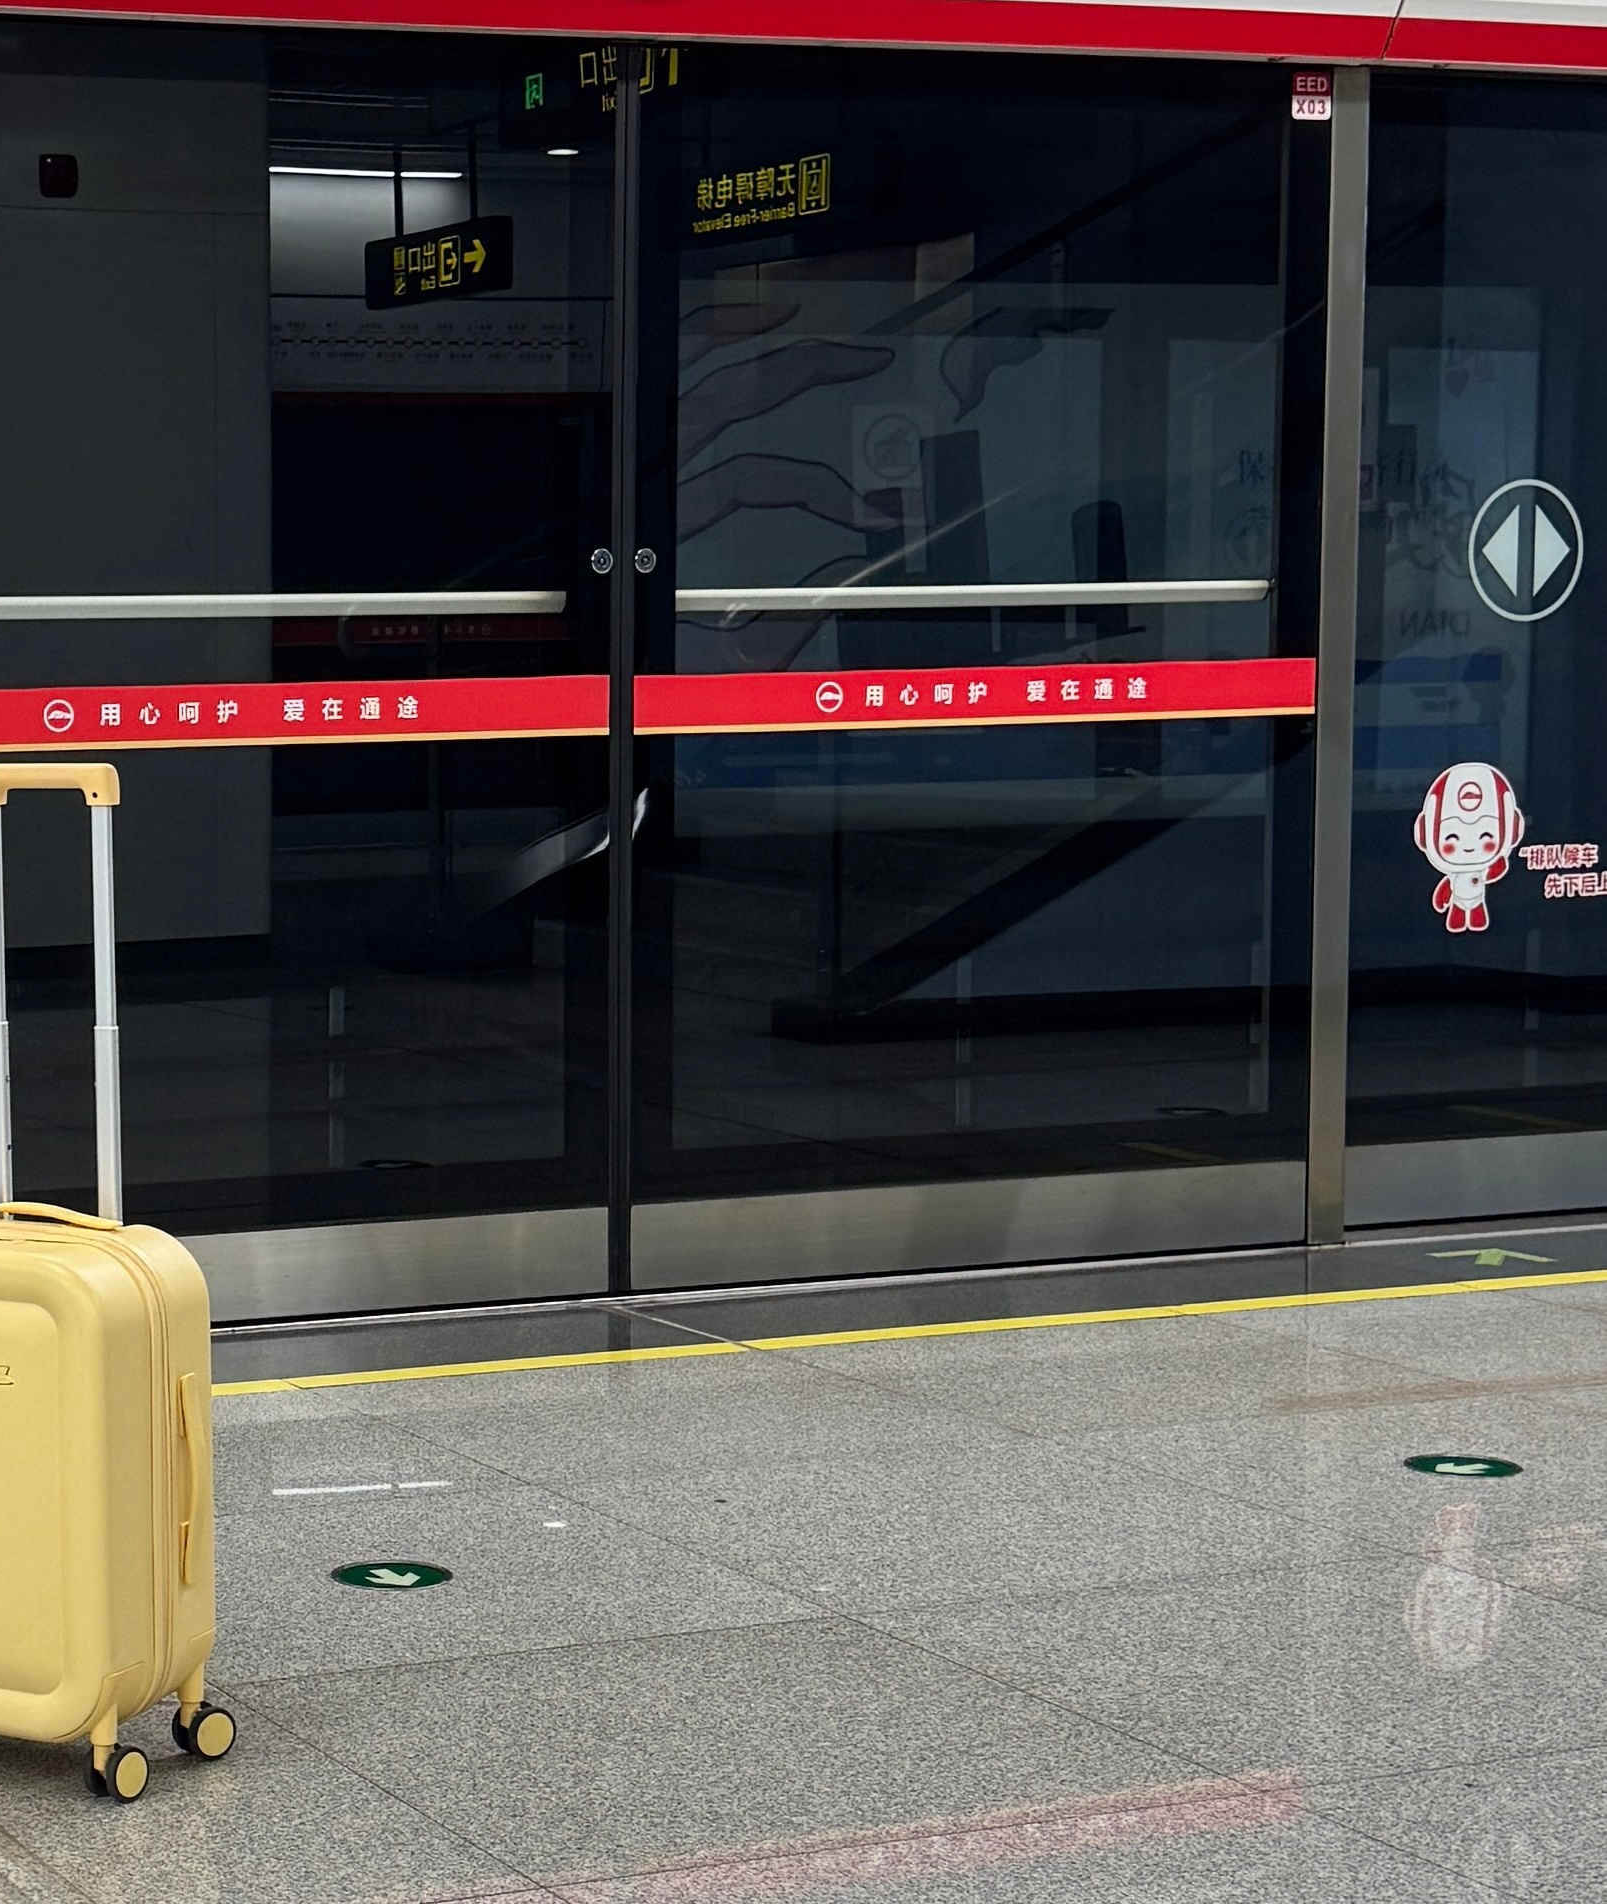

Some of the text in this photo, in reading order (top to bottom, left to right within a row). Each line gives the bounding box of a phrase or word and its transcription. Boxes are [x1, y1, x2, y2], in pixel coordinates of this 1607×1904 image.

[1296, 76, 1328, 92] EED
[1296, 99, 1326, 115] X03
[864, 676, 1148, 707] 用心呵护 爱在通途
[99, 695, 420, 729] 用心呵护 爱在通途
